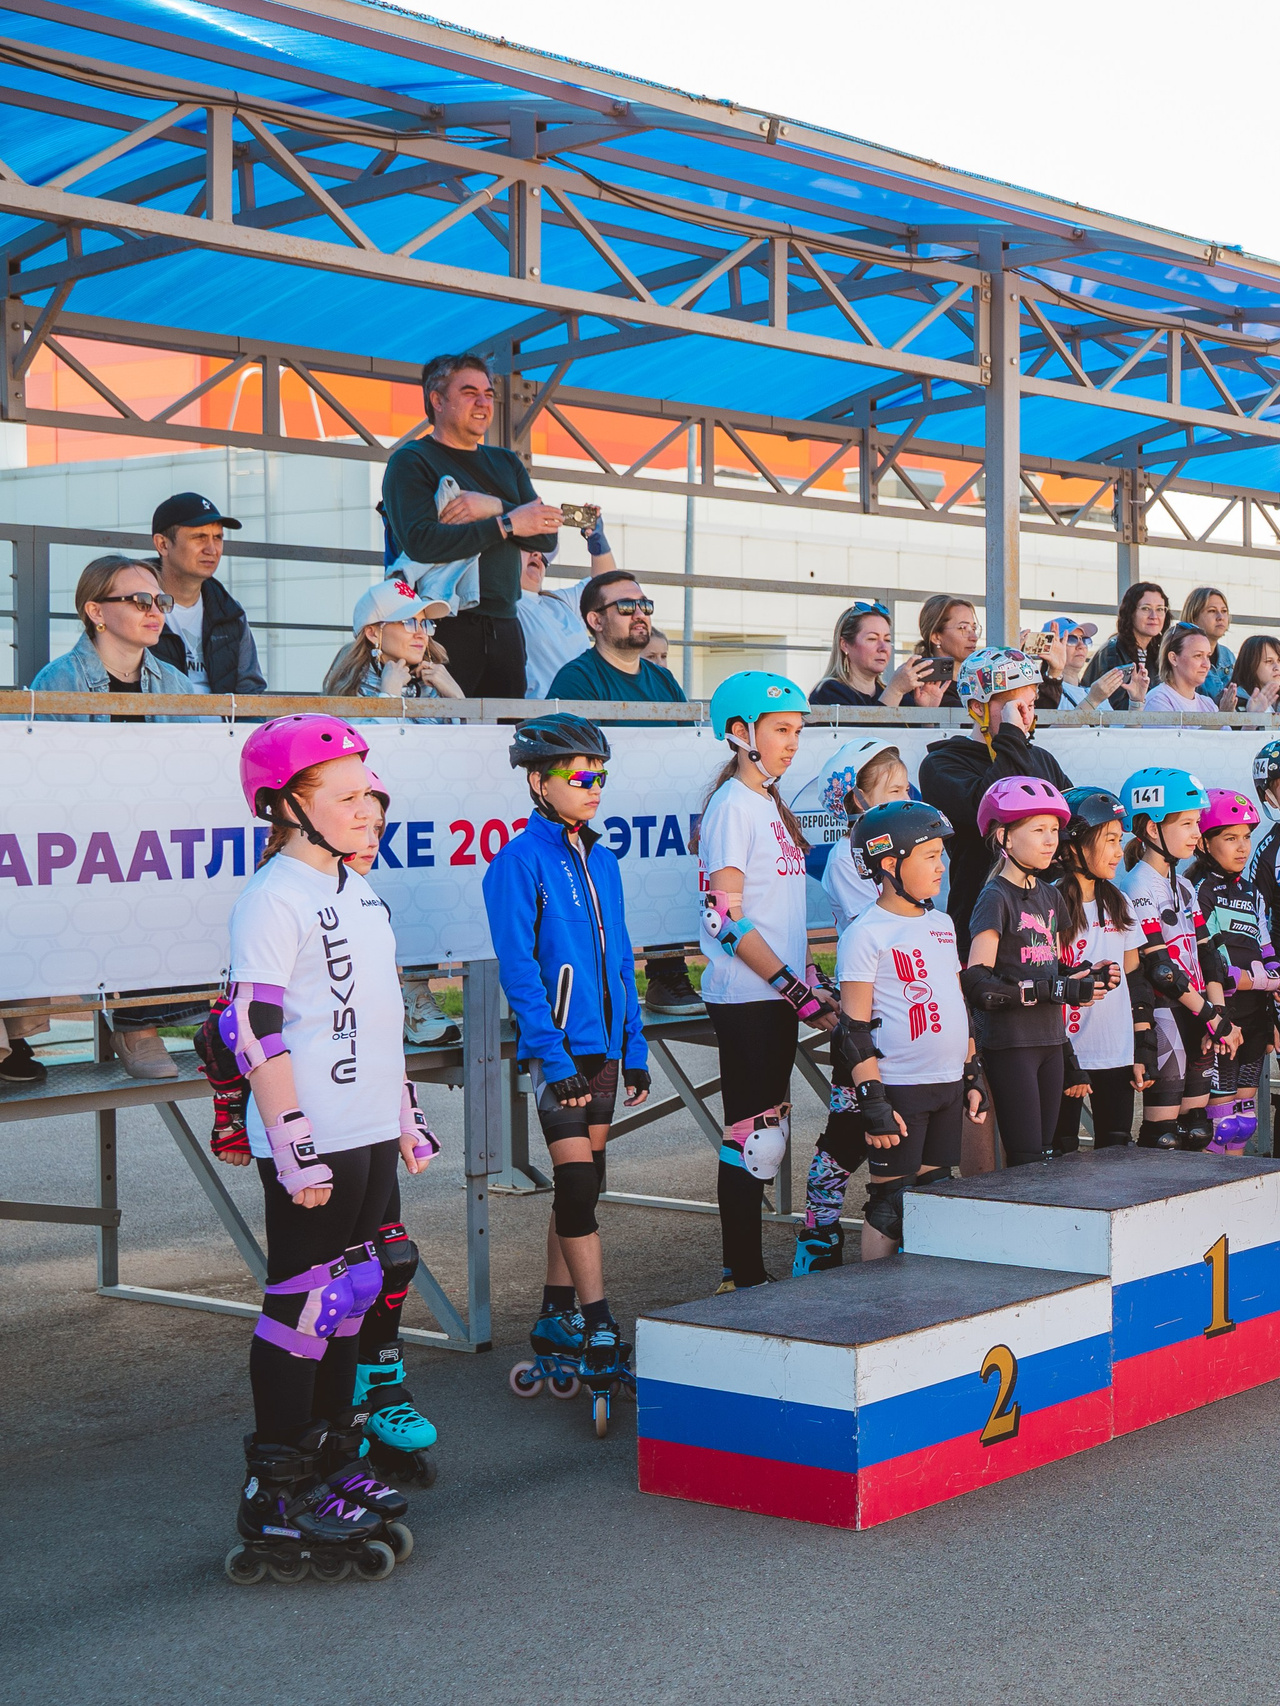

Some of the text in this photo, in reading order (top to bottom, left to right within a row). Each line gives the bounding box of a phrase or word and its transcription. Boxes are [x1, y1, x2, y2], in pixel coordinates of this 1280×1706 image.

[797, 814, 843, 828] СЕРОСС
[1133, 787, 1160, 804] 141
[1203, 1232, 1237, 1339] 1
[979, 1343, 1022, 1448] 2
